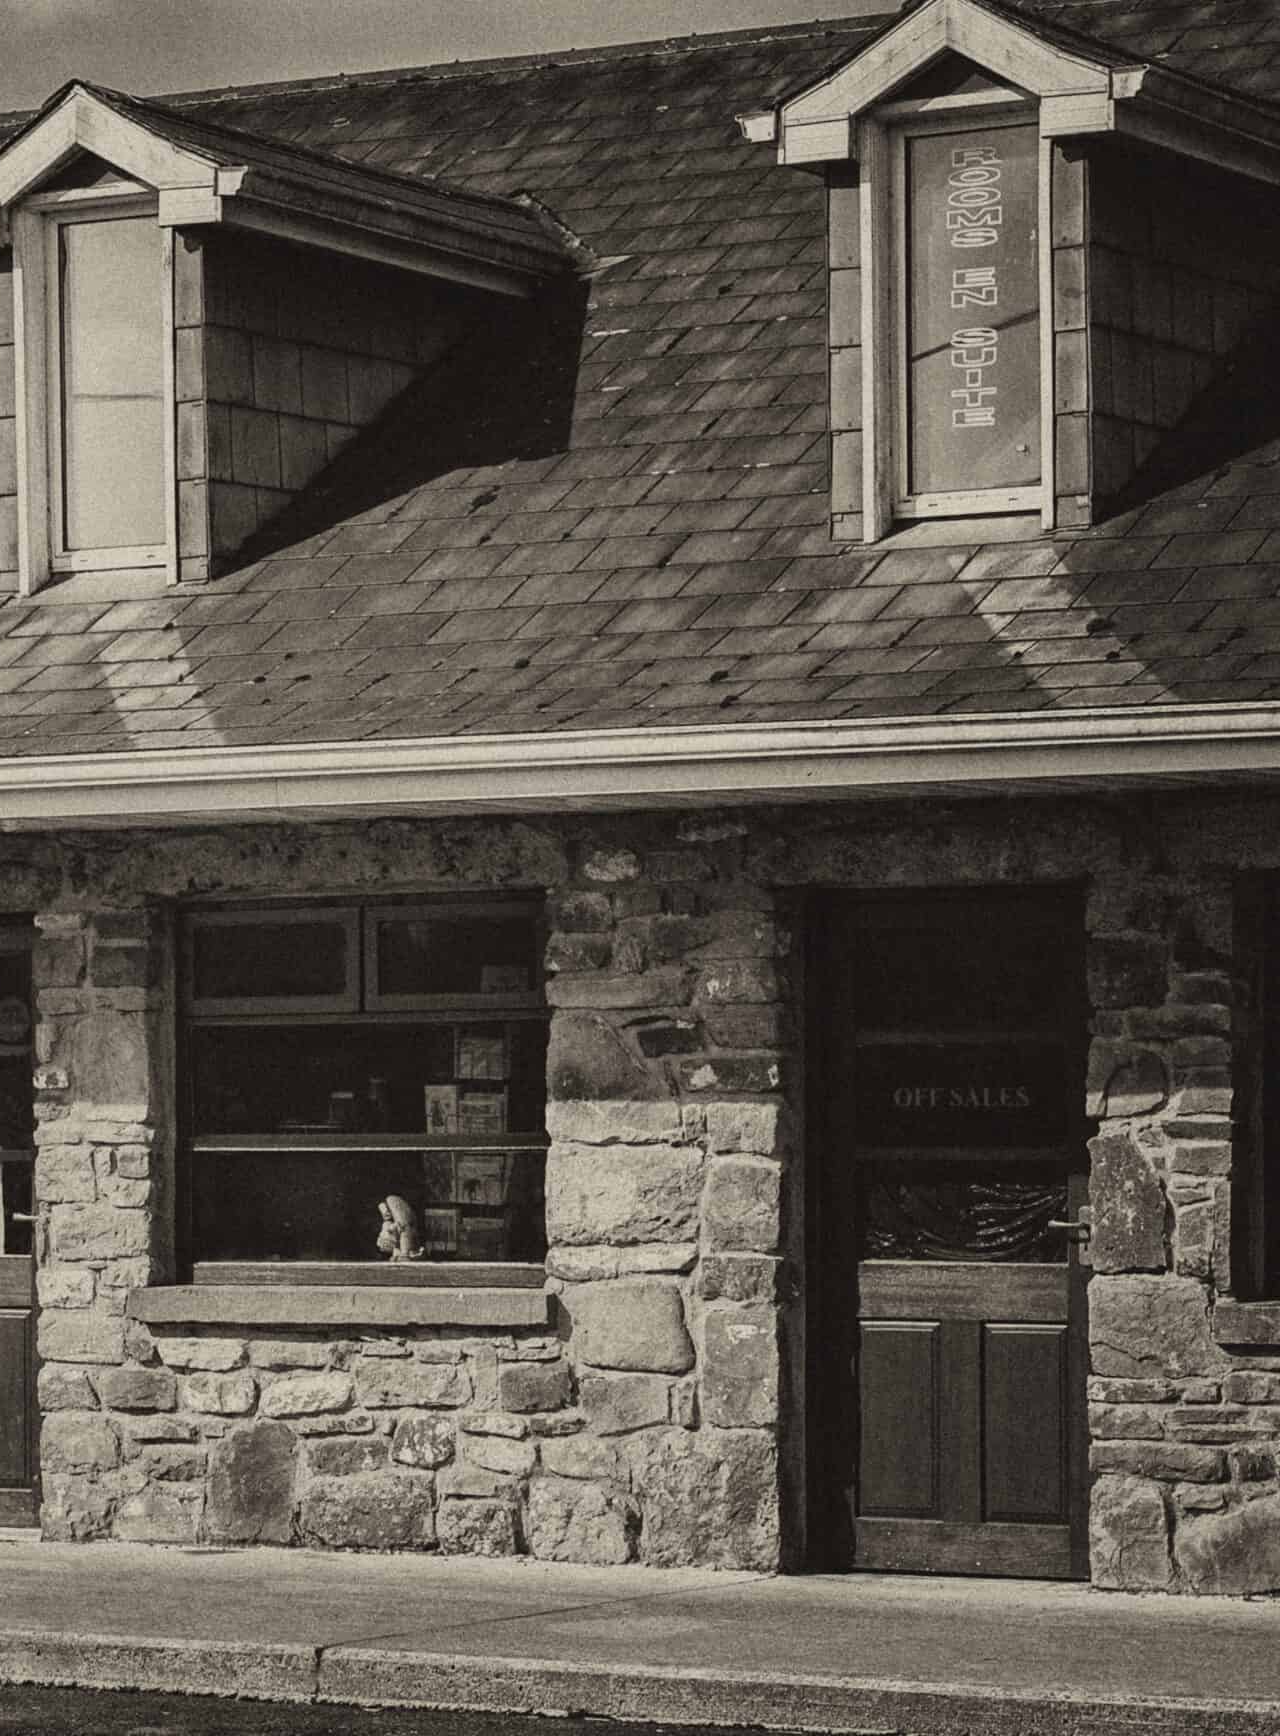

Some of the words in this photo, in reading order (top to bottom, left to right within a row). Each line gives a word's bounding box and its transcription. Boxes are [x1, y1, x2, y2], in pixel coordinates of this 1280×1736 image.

[947, 147, 1003, 248] ROOMS
[951, 266, 998, 309] EN
[951, 327, 998, 428] SUITE
[893, 1086, 945, 1107] OFF
[950, 1085, 1031, 1107] SALES
